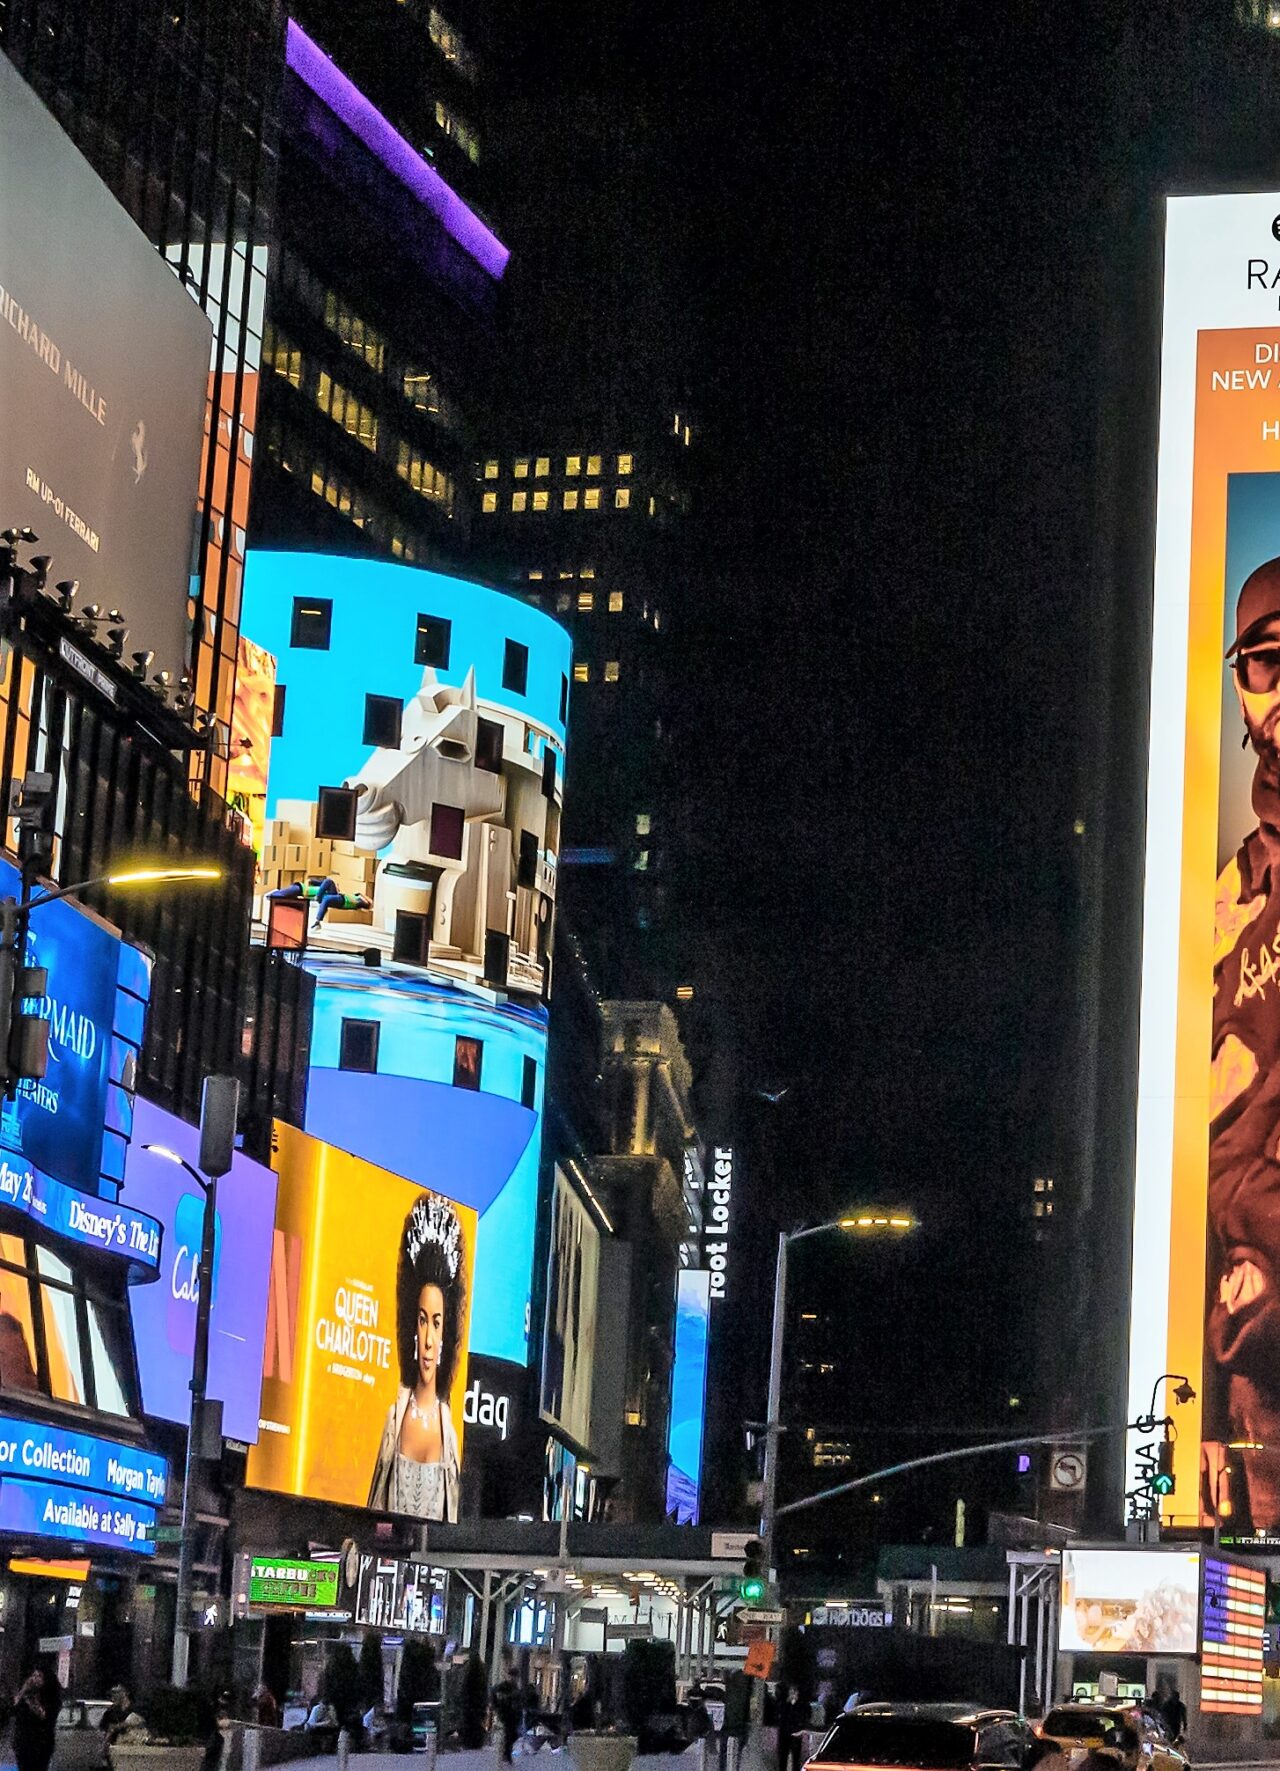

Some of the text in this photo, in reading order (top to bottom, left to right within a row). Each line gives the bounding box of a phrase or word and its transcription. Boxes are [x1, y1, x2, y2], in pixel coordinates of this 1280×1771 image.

[64, 360, 107, 426] MILLE
[1211, 369, 1271, 391] NEW
[65, 506, 100, 553] FERRARI
[68, 1200, 127, 1247] Disney's
[129, 1220, 149, 1253] The
[335, 1286, 379, 1329] QUEEN
[315, 1317, 392, 1369] CHARLOTTE
[22, 1439, 90, 1477] Collection
[107, 1458, 144, 1492] Morgan
[42, 1498, 99, 1531] Available
[101, 1511, 112, 1533] at
[113, 1511, 136, 1542] Sally
